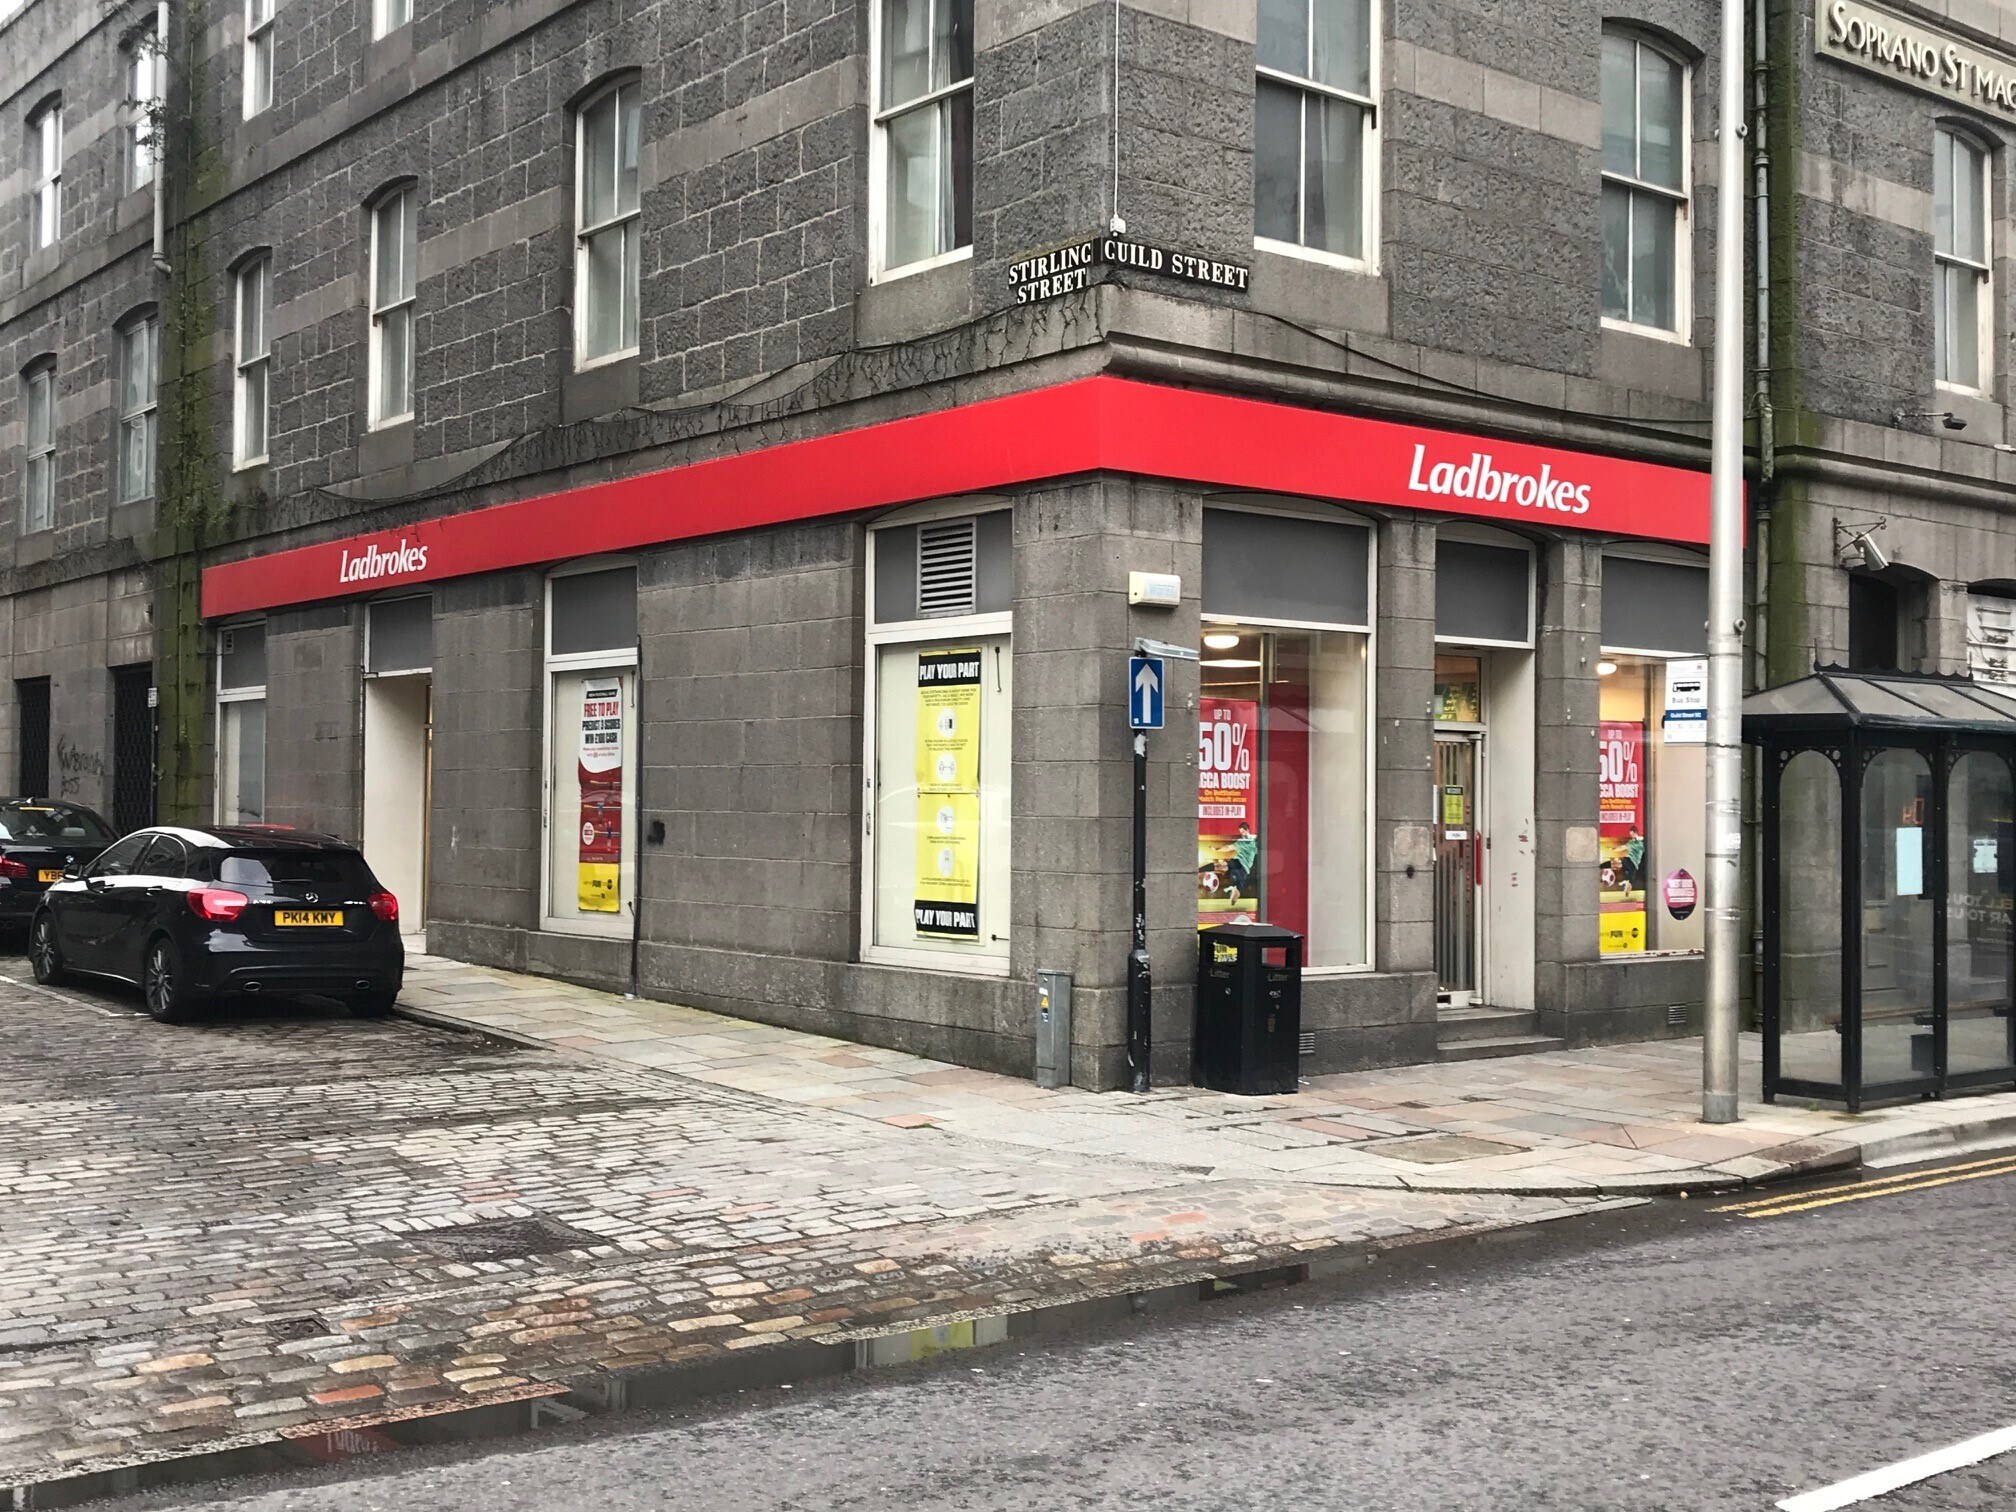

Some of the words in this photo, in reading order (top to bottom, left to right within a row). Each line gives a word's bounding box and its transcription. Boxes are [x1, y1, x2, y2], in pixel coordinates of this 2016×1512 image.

[1830, 0, 1940, 77] SOPRANO
[1008, 242, 1091, 285] STIRLING
[1104, 240, 1164, 270] GUILD
[1171, 254, 1248, 289] STREET
[1017, 268, 1087, 304] STREET
[1408, 443, 1592, 515] Ladbrokes
[340, 538, 429, 583] Ladbrokes
[919, 664, 936, 680] PLAY
[936, 662, 957, 679] YOUR
[957, 661, 980, 678] PART
[584, 702, 597, 717] FREE
[597, 702, 606, 717] TO
[605, 701, 619, 717] PLAY
[1685, 696, 1701, 704] Stop
[1213, 709, 1223, 720] UP
[1222, 709, 1232, 720] TO
[1199, 721, 1250, 772] 50%
[1600, 740, 1638, 783] 50%
[1199, 771, 1219, 789] CCA
[1220, 772, 1251, 790] BOOST
[1614, 783, 1639, 798] BOOST
[282, 911, 310, 924] PK14
[915, 908, 935, 926] PLAY
[935, 909, 953, 927] YOUR
[953, 910, 976, 928] PART
